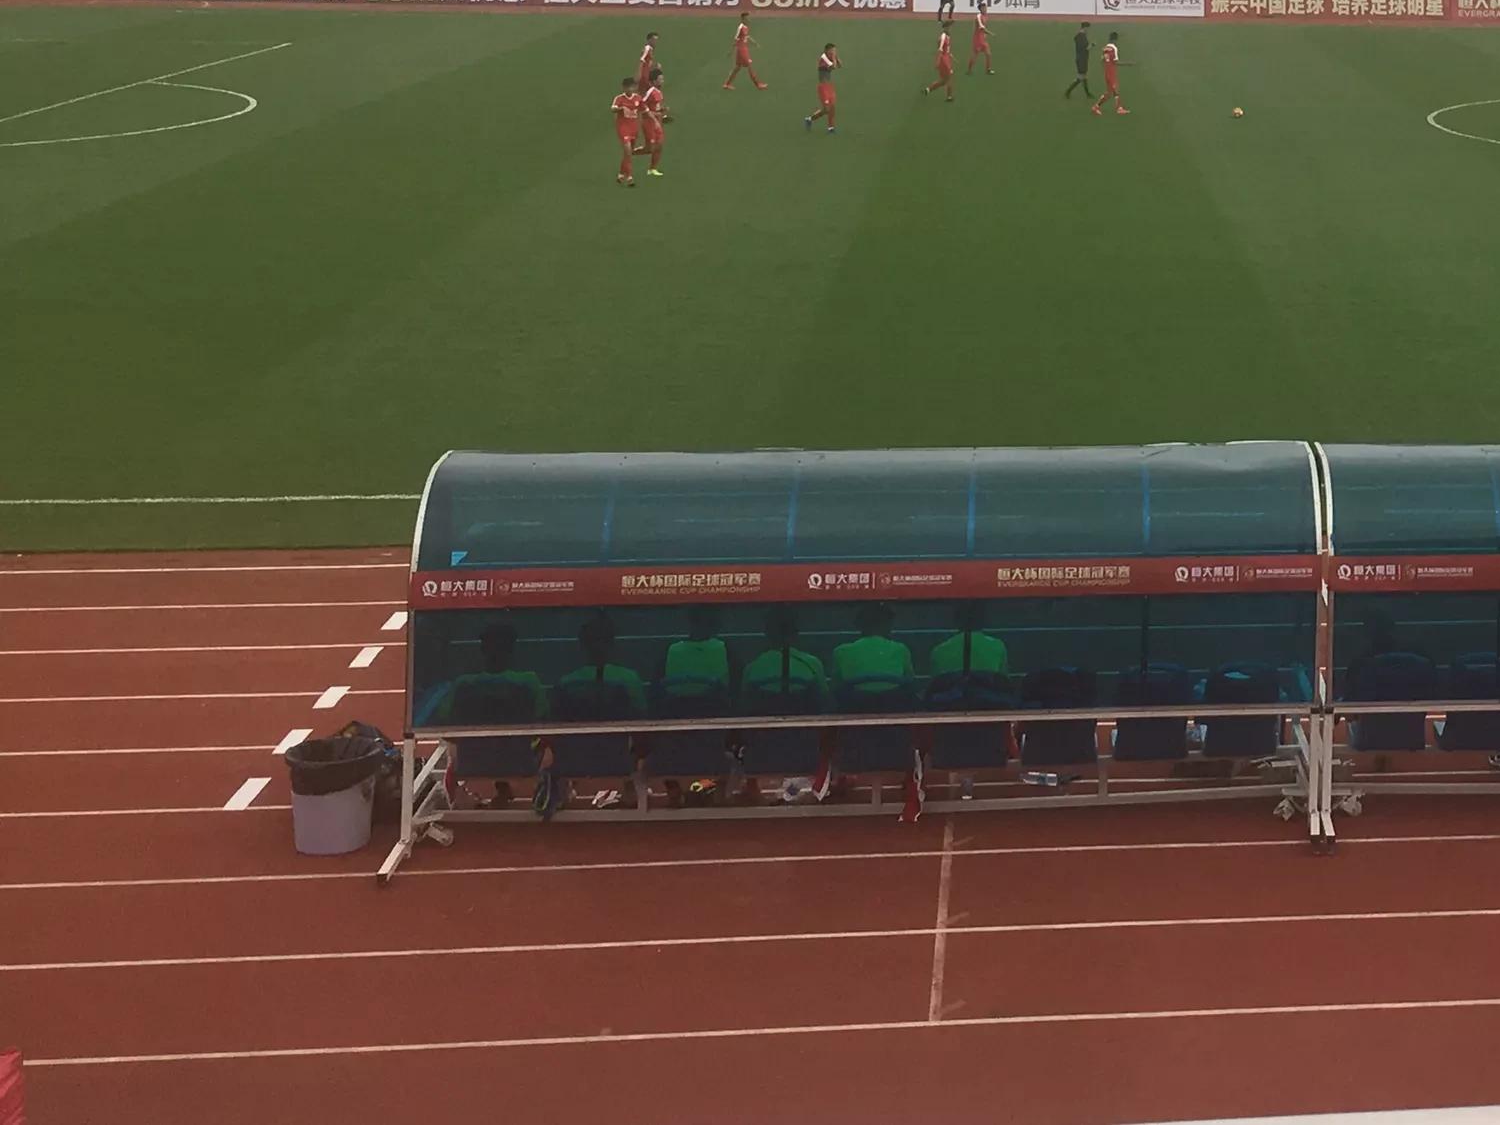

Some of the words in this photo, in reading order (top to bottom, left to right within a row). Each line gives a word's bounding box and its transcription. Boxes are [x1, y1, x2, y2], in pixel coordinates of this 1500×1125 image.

[621, 573, 760, 588] 恒大杯国际足球冠军赛
